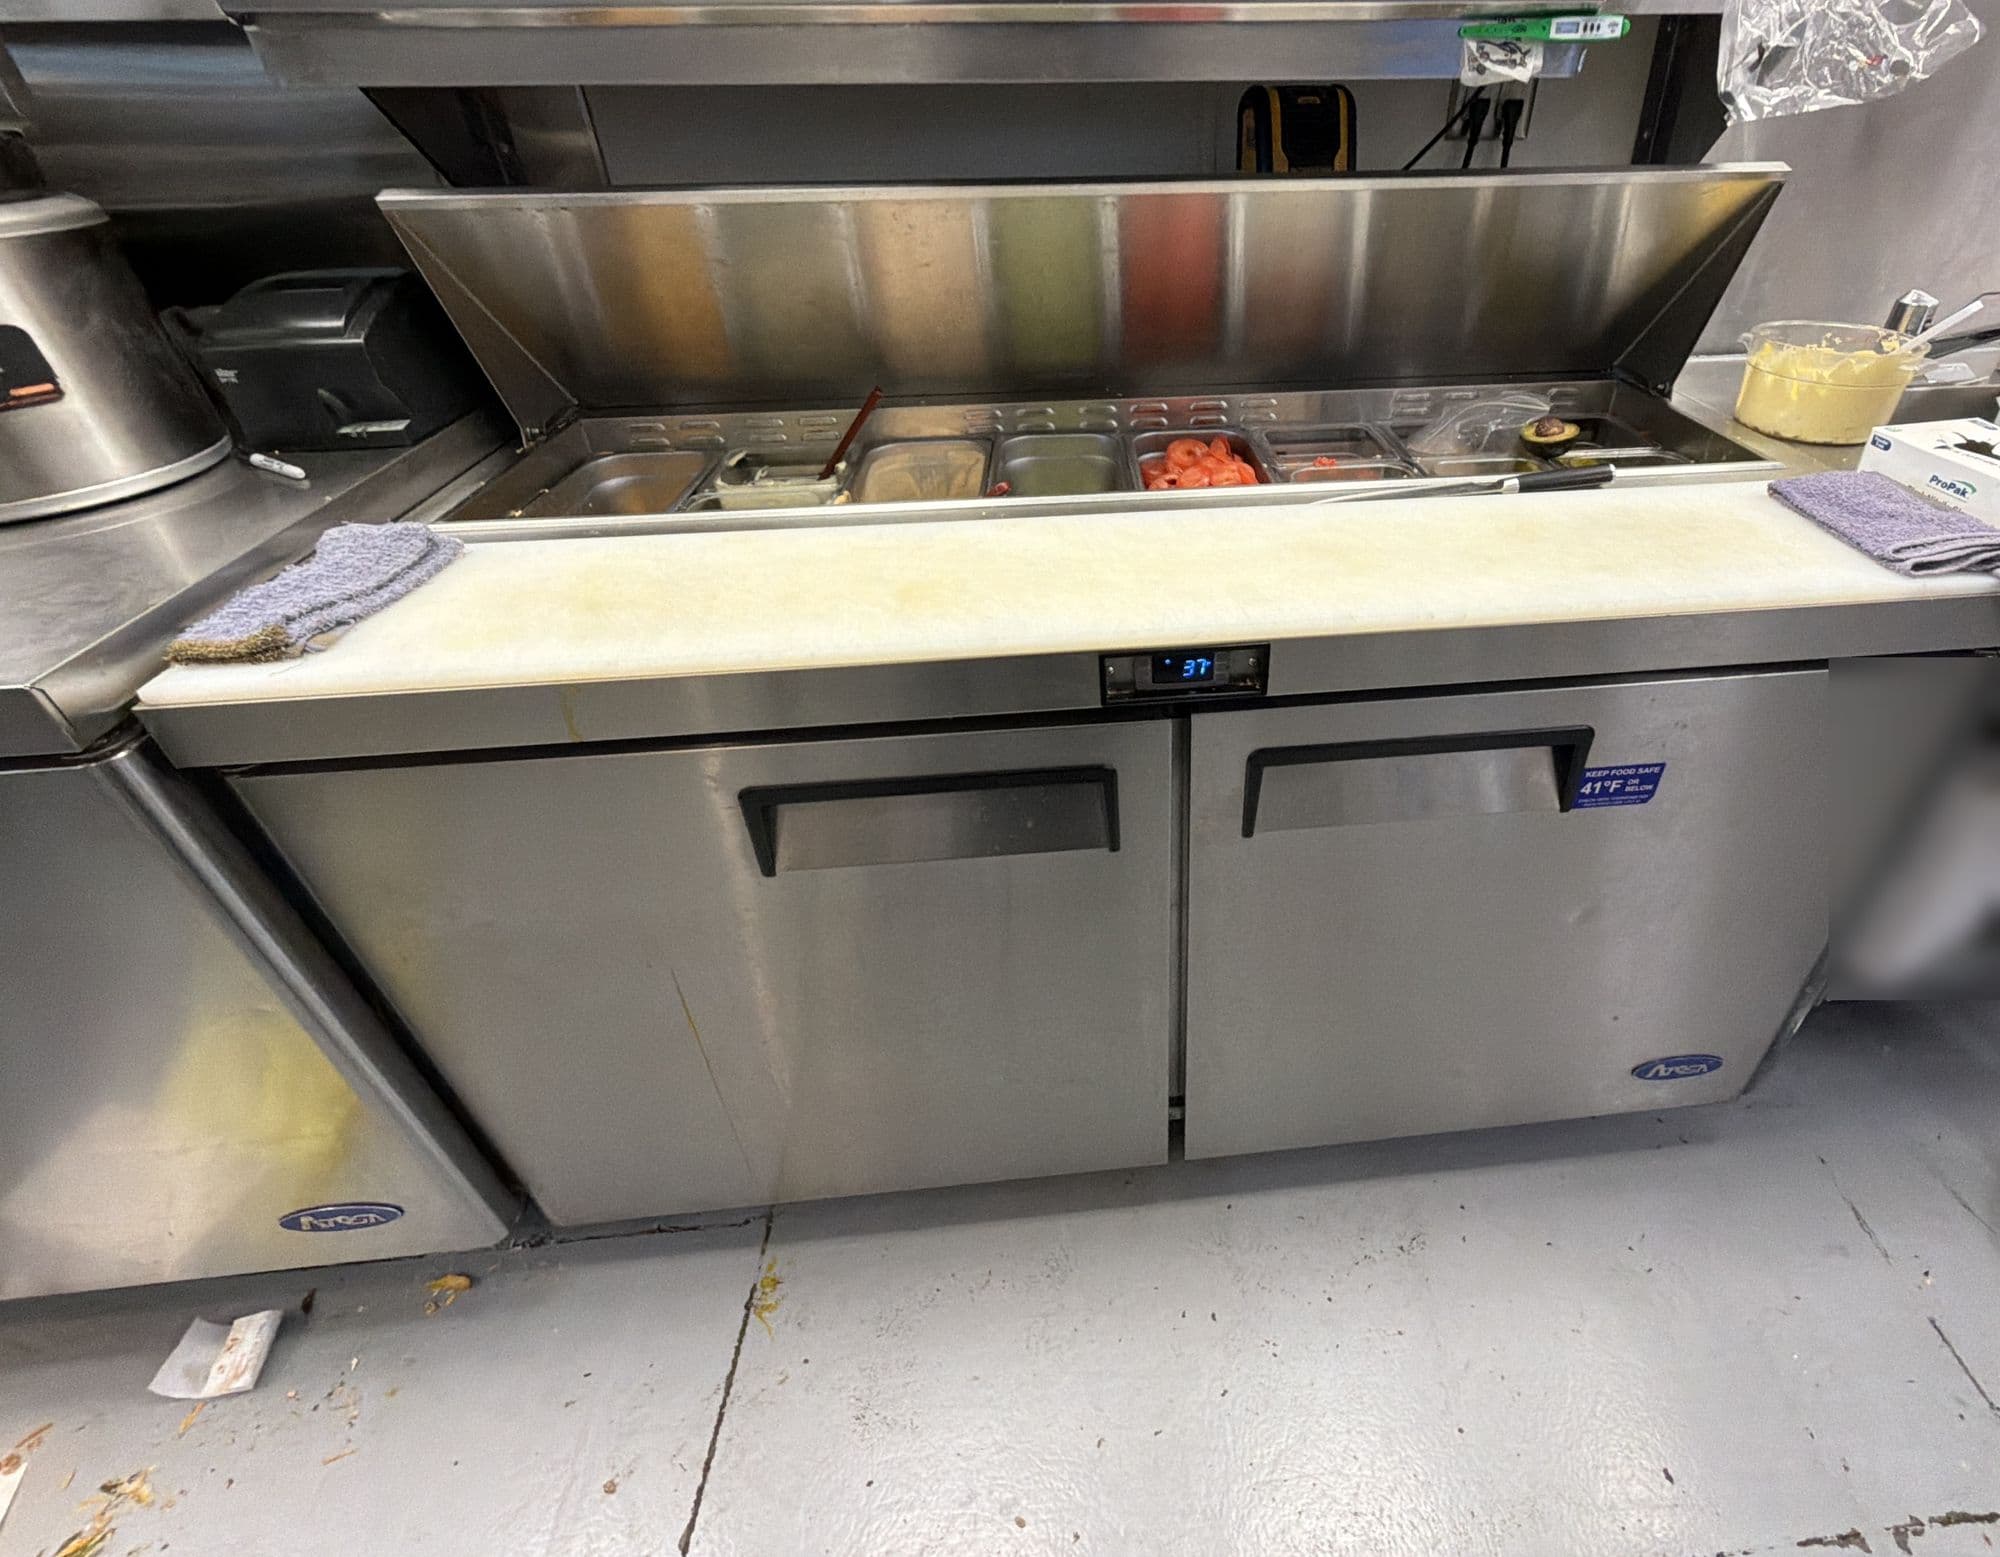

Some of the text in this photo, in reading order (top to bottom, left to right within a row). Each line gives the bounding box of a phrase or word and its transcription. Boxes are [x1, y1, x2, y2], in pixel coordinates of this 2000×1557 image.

[1929, 474, 1969, 498] ProPak
[1585, 766, 1661, 778] KEEP FOOD SAFE
[1580, 780, 1624, 794] 41°F
[1624, 784, 1654, 792] BELOW
